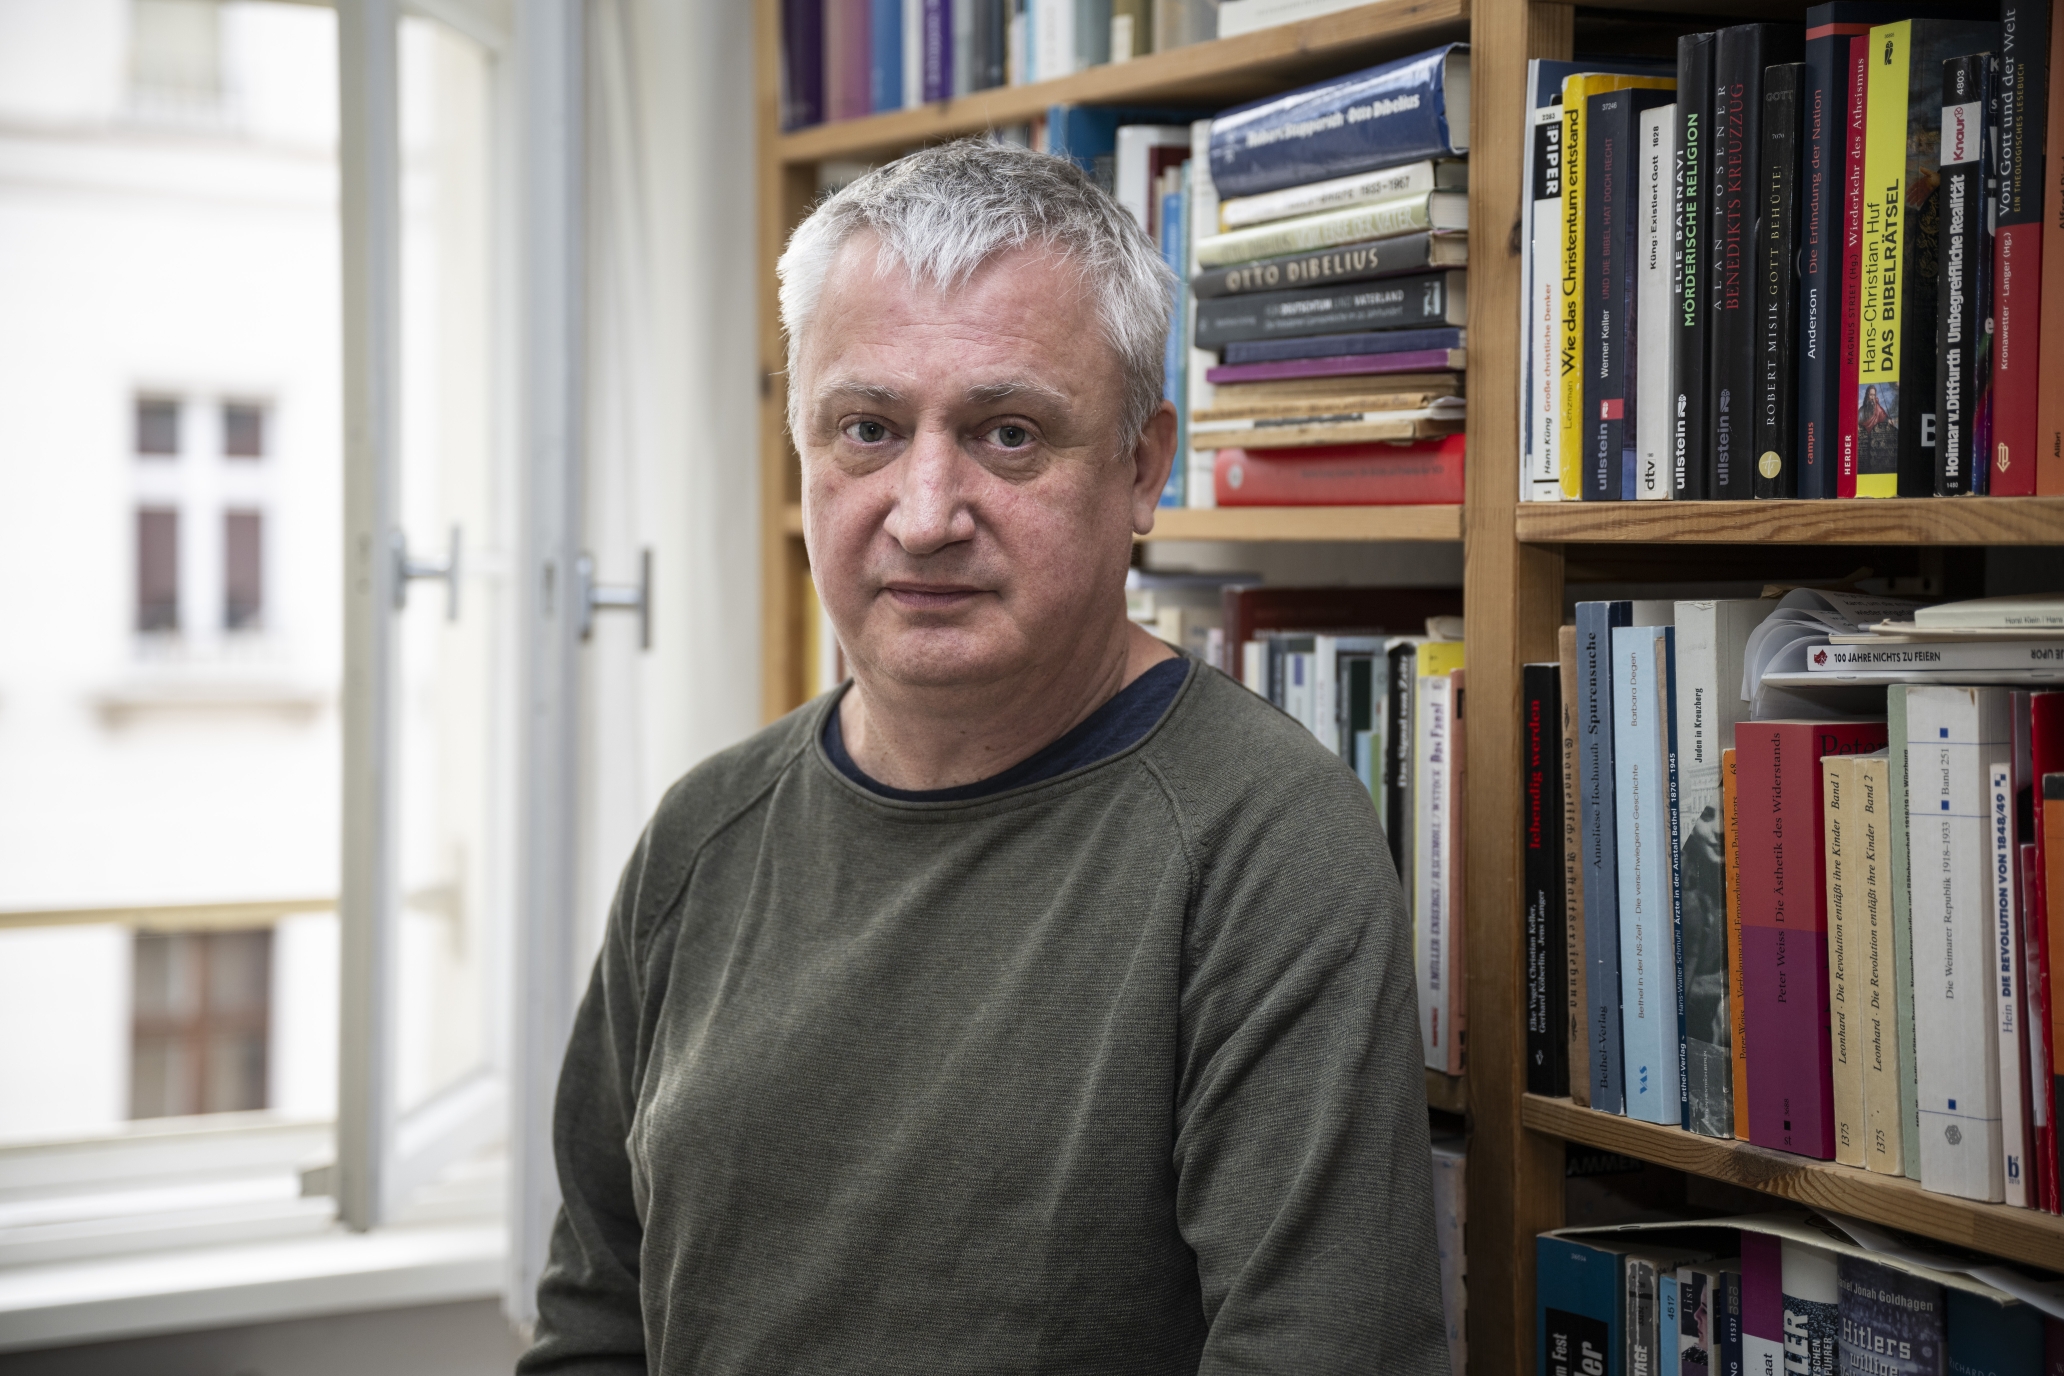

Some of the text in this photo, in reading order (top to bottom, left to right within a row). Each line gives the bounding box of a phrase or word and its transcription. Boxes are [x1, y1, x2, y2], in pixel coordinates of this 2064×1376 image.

[1853, 58, 1864, 129] Atheismus
[1956, 70, 1965, 95] 4803
[1999, 8, 2016, 216] Von Gott und der Welt
[1851, 136, 1861, 158] des
[2014, 63, 2024, 193] THEOLOGISCHES LESEBUCH
[1546, 129, 1559, 195] PIPER
[1604, 174, 1612, 202] DOCH
[1676, 150, 1684, 240] BARNAVI
[1683, 113, 1698, 326] MÖRDERISCHE RELIGION
[1726, 84, 1743, 309] BENEDIKTS KREUZZUG
[1808, 90, 1822, 359] Anderson Die Erfindung der Nation
[1849, 165, 1860, 247] Wiederkehr
[1225, 248, 1378, 291] OTTO DIBELIUS
[1562, 109, 1579, 377] Wie das Christentum entstand
[1603, 228, 1611, 256] BIBEL
[1881, 179, 1899, 372] DAS BIBELRÄTSEL
[1766, 165, 1781, 425] ROBERT MISIK GOTT BEHÜTE!
[1863, 202, 1880, 373] Hans-Christian Huf
[2001, 261, 2011, 370] Kronawetter Langer
[1601, 310, 1610, 338] Keller
[1847, 322, 1855, 364] MAGNUS
[1945, 175, 1965, 476] Hoimar Unbegreifliche Realität
[1601, 342, 1609, 378] Werner
[1544, 417, 1552, 445] Küng
[1598, 423, 1608, 490] ullstein
[1676, 421, 1686, 489] ullstein
[1717, 416, 1730, 486] ullstein
[1806, 422, 1815, 464] campus
[1645, 461, 1655, 490] dtv
[1630, 652, 1638, 685] Degen
[1834, 651, 1941, 663] 100 JAHRE NICHTS FEIERN
[1586, 632, 1602, 869] Anneliese Hochmuth Spurensuche
[1694, 688, 1703, 763] Juden Kreuzberg
[1529, 699, 1543, 849] lebendig werden
[1632, 764, 1640, 820] Geschichte
[1633, 822, 1642, 896] verschwiegene
[1771, 733, 1787, 1003] Peter Weiss Die Ästhetik des Widerstands
[1940, 748, 1954, 999] Die Weimarer Republik Band 251
[1635, 924, 1643, 957] NS-Zeit
[1831, 784, 1847, 1064] Leonhard Die Revolution entläßt ihre Kinder Band
[1864, 784, 1883, 1072] Leonhard Die Revolution entläßt ihre Kinder Band
[1996, 793, 2013, 1033] Hein DIE REVOLUTION VON 1848/49
[1528, 936, 1537, 979] Christian
[1537, 889, 1546, 1033] Gerhard Langer
[1676, 966, 1684, 1015] Hans-Walter
[1637, 987, 1645, 1019] Bethel
[1598, 1006, 1608, 1088] Bethel-Verlag
[1639, 1065, 1647, 1094] VAS
[1679, 1043, 1687, 1102] Bethel-Verlag
[1841, 1122, 1850, 1147] 1375
[1876, 1129, 1886, 1154] 1375
[1684, 1287, 1692, 1313] List
[1880, 1291, 1933, 1311] Goldhagen
[1823, 1337, 1832, 1376] FÜHRER
[1842, 1317, 1911, 1360] Hitlers
